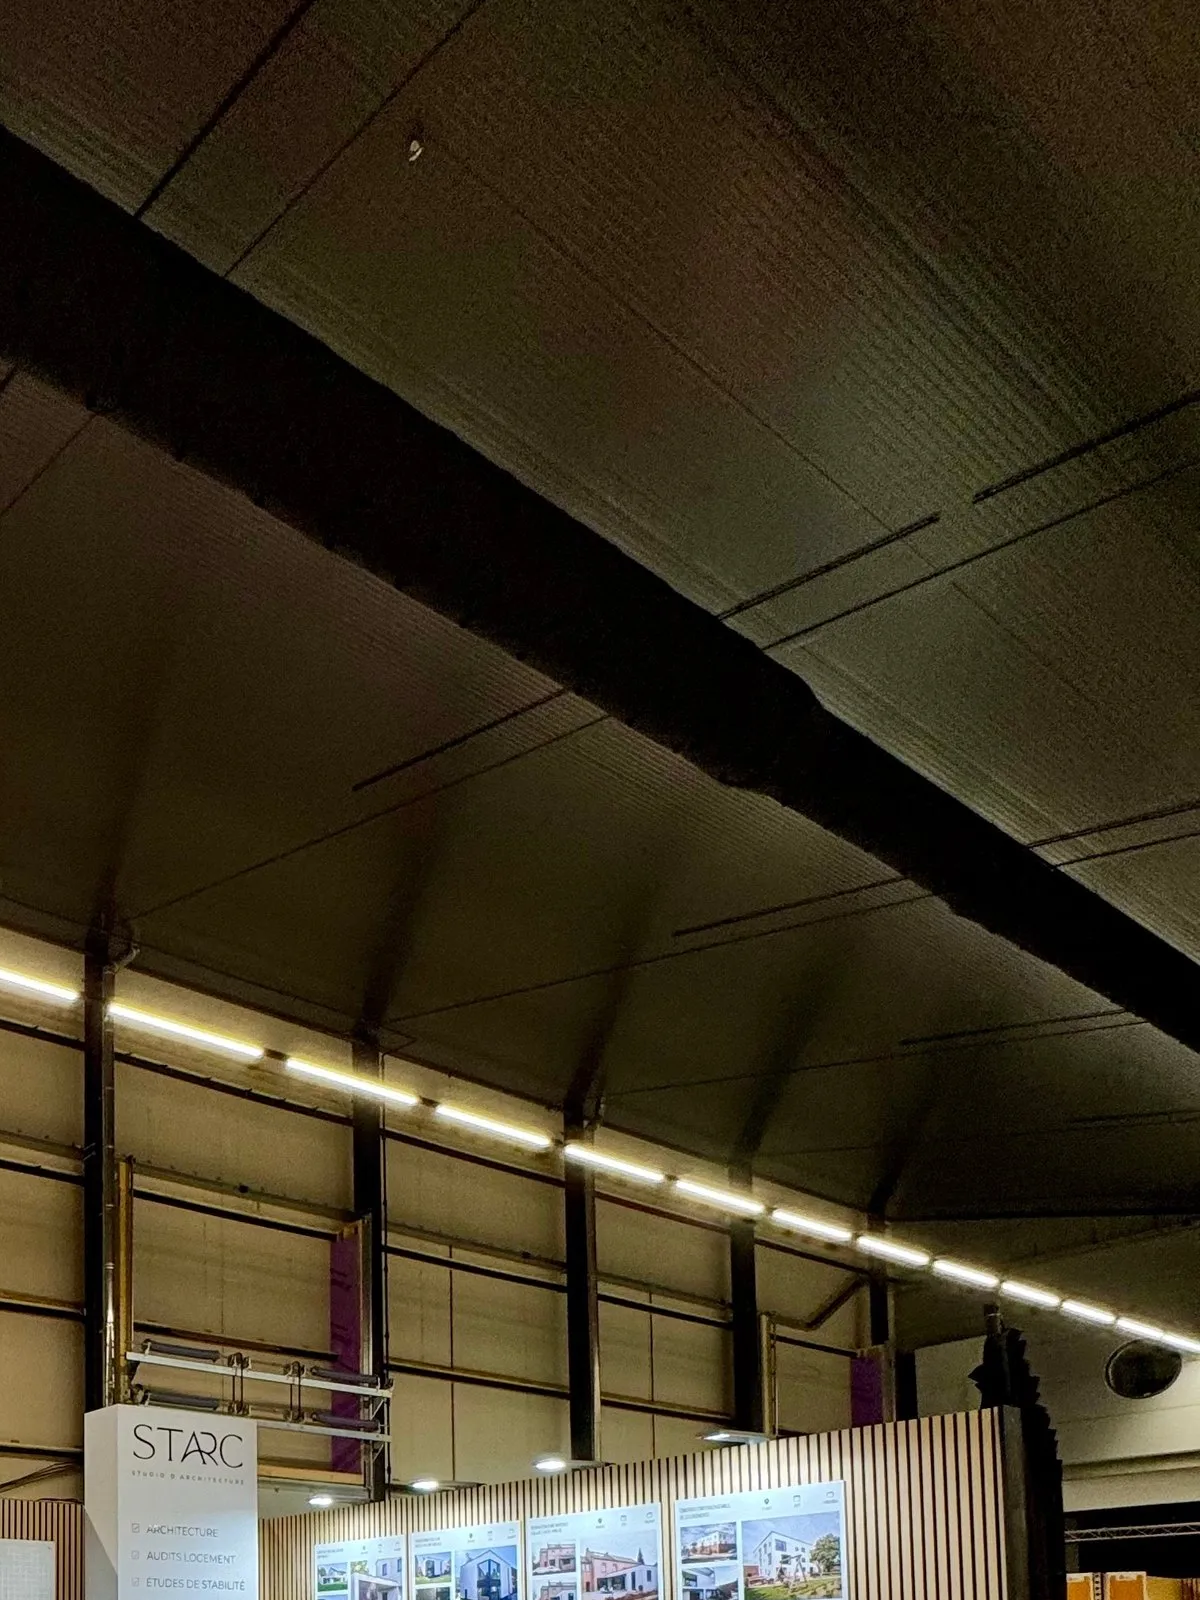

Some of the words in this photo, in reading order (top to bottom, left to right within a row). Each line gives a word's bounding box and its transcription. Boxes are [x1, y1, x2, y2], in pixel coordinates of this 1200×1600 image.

[133, 1424, 243, 1468] STARC
[170, 1473, 244, 1485] DARCHITECTURE
[146, 1525, 219, 1537] ARCHITECTURE
[146, 1551, 181, 1561] AUDITS
[186, 1579, 199, 1588] DE
[201, 1579, 245, 1591] STABILITÉ
